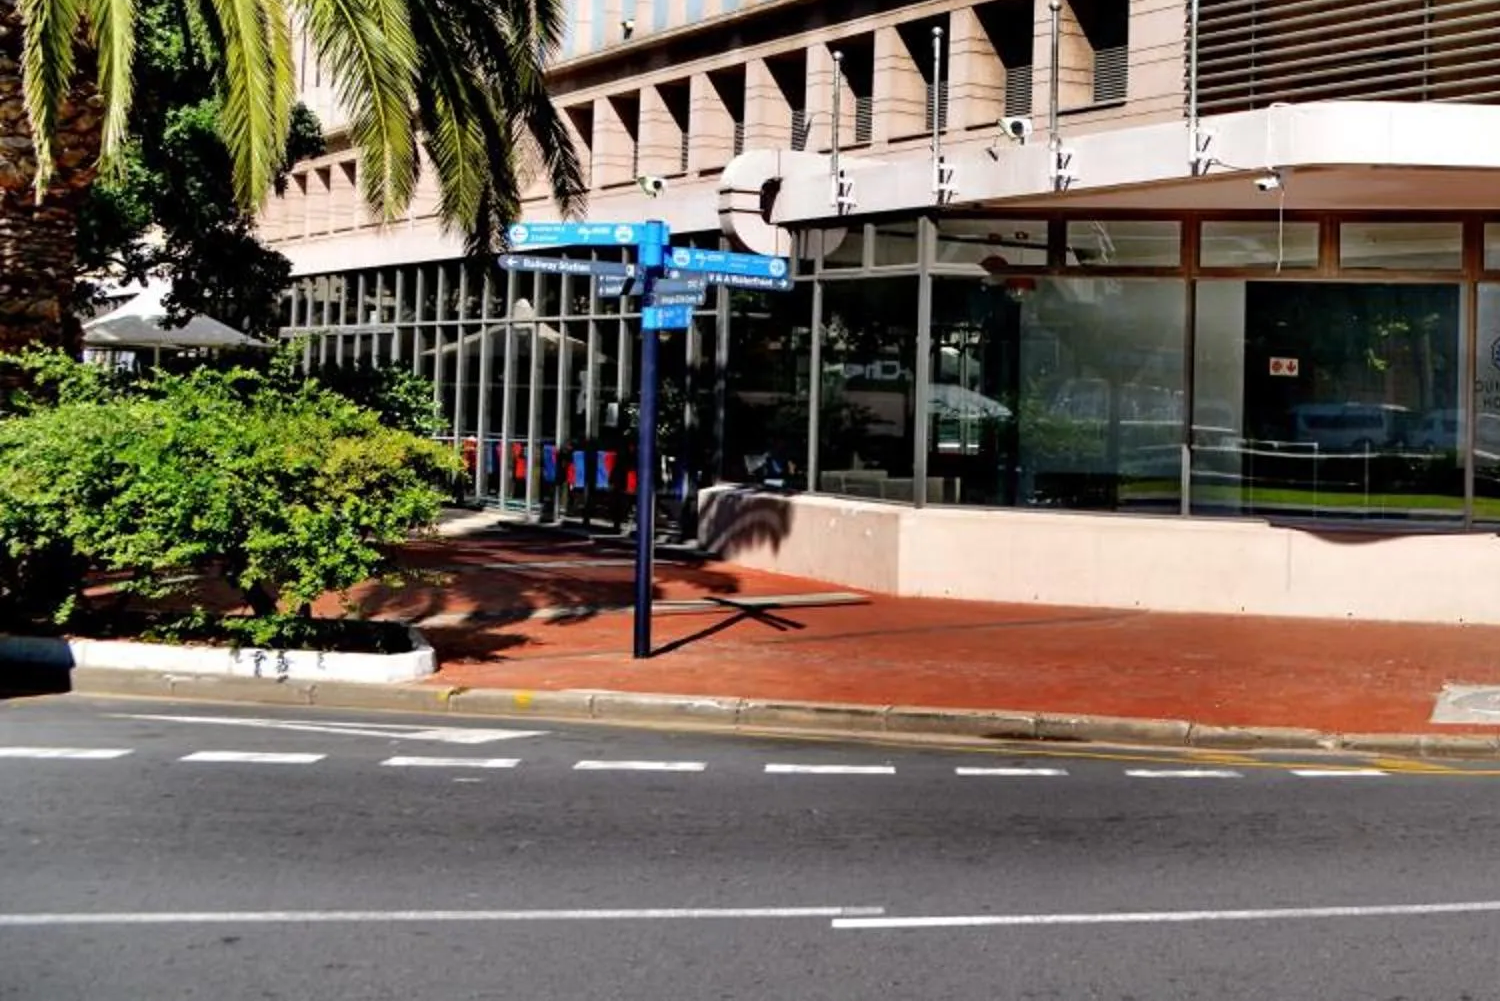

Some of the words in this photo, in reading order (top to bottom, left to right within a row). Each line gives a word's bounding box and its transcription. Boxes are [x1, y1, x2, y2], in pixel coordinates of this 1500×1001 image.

[523, 258, 556, 272] Railway
[558, 260, 591, 273] Station
[731, 274, 773, 287] Waterfront
